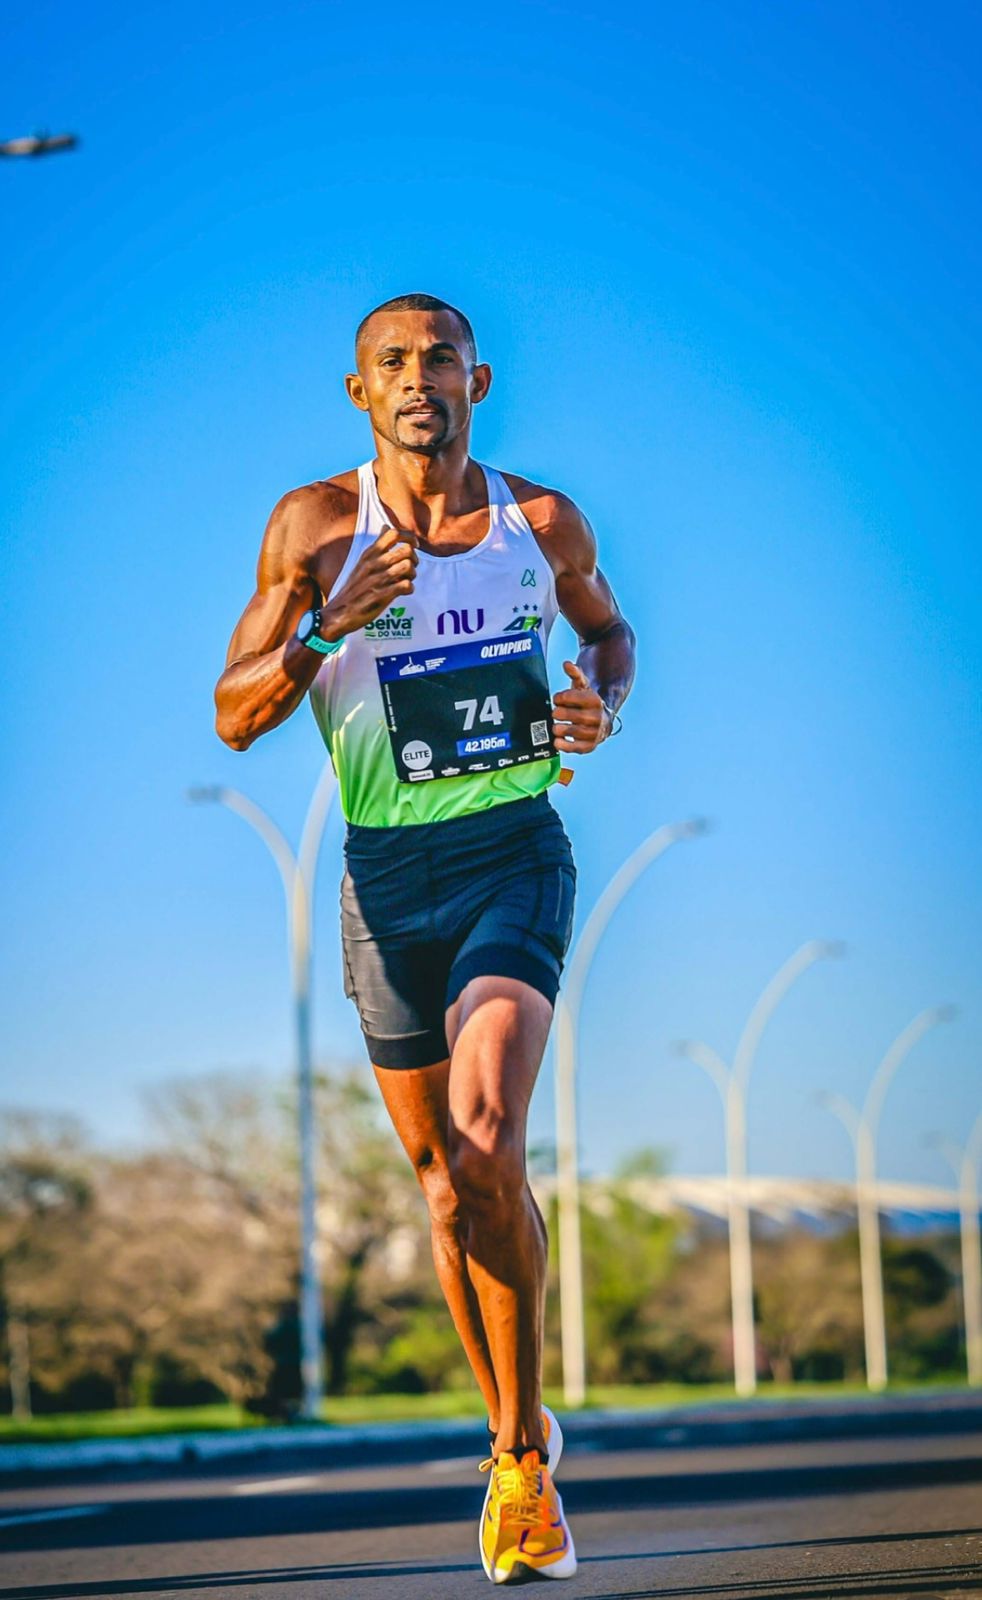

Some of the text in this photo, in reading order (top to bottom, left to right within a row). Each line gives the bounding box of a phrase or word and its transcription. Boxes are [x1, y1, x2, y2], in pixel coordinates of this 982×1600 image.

[481, 638, 532, 659] OLYMPIKUS
[454, 695, 504, 731] 74
[403, 750, 430, 761] ELITE
